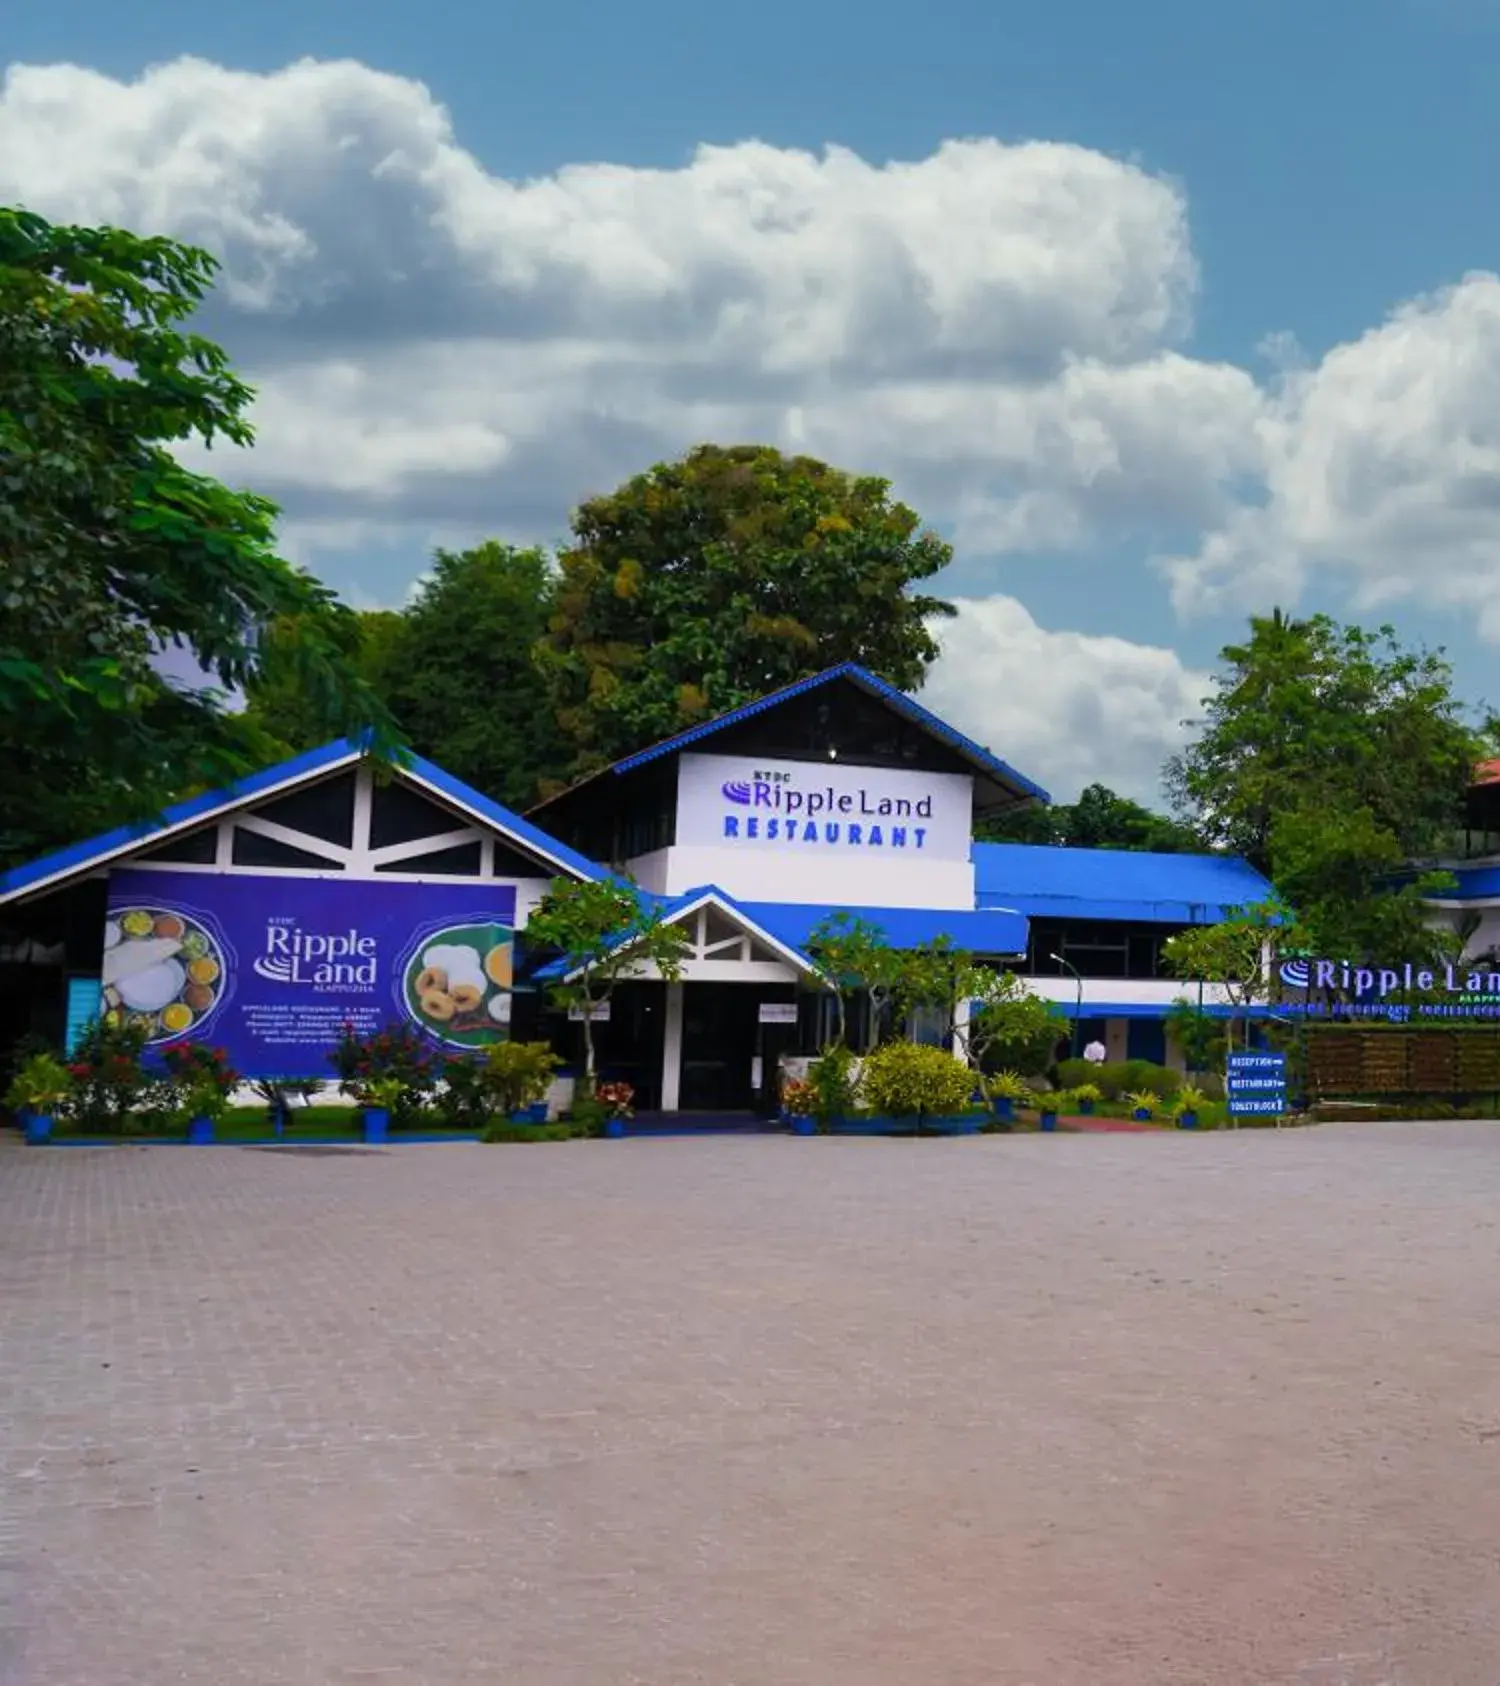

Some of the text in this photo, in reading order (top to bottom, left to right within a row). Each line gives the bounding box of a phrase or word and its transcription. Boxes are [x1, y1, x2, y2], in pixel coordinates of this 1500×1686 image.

[753, 782, 933, 818] Ripple Land
[724, 815, 927, 848] RESTAURANT
[267, 926, 377, 962] Ripple
[291, 956, 377, 984] Land
[1317, 959, 1435, 997] Ripple
